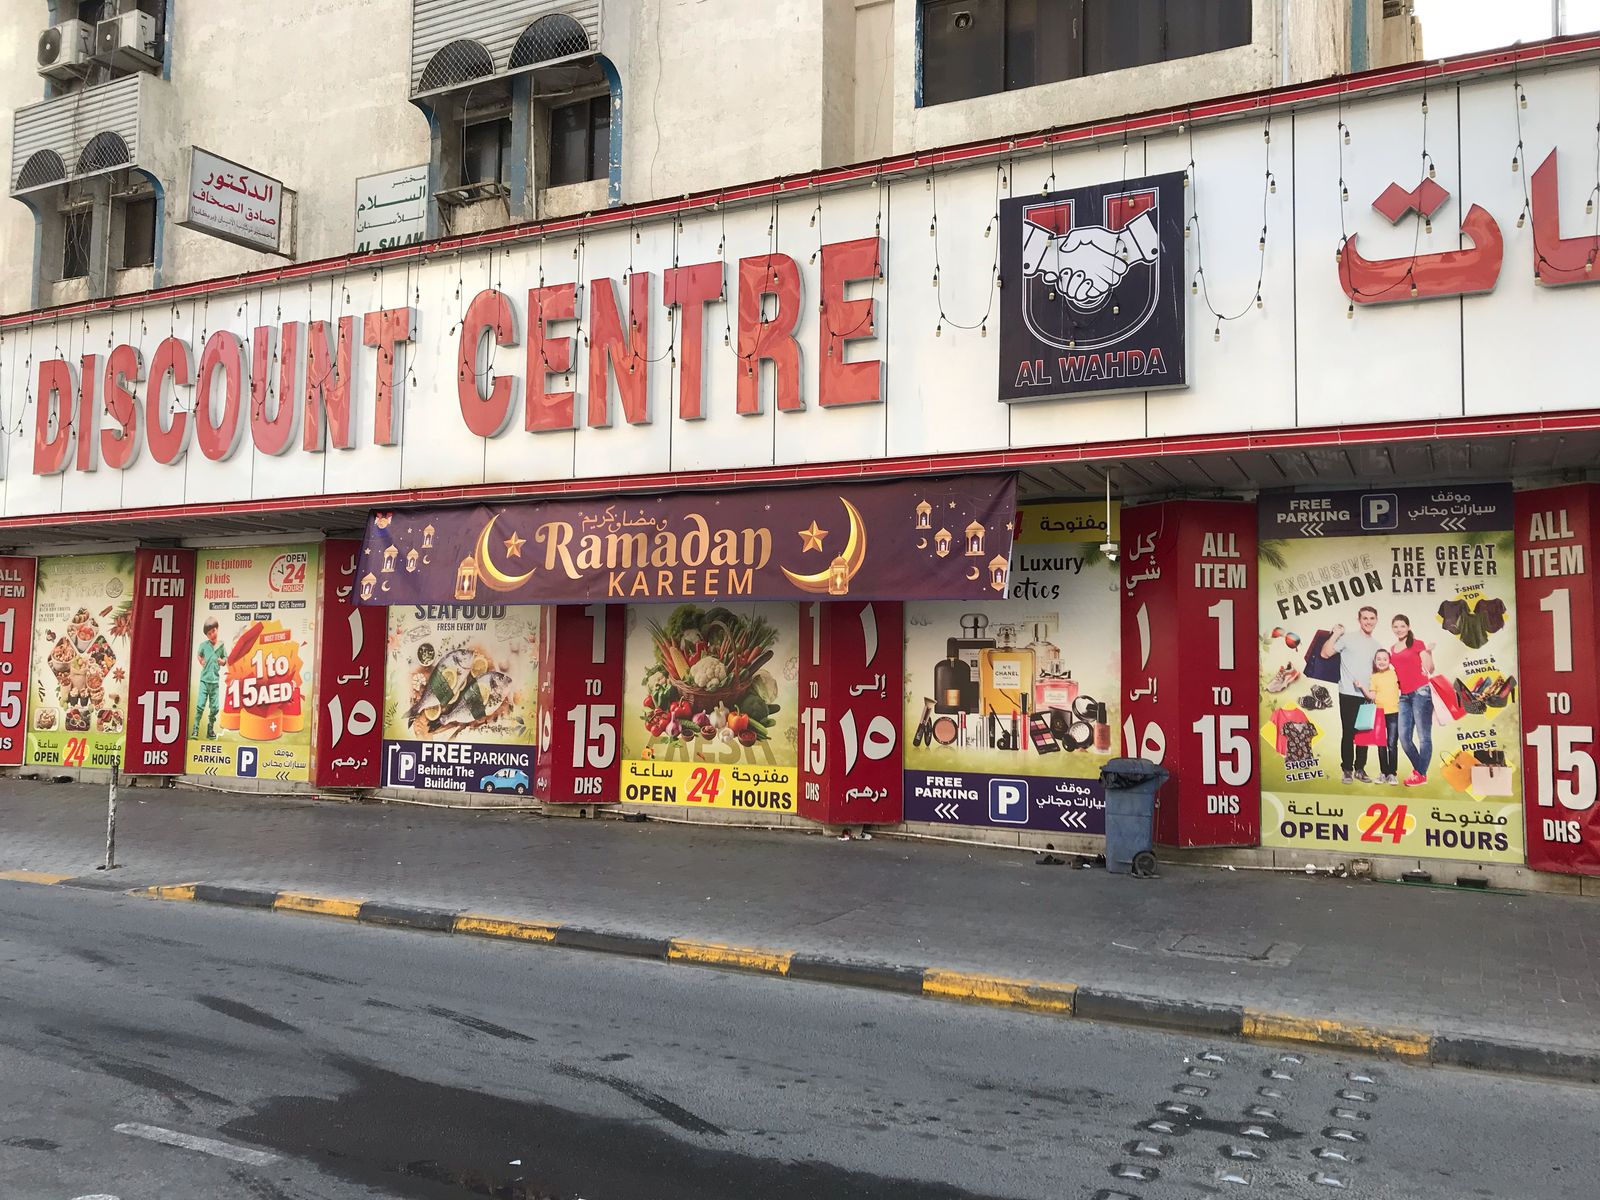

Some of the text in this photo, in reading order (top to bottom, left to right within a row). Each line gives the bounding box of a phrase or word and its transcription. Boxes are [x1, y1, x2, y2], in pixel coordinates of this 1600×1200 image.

[202, 172, 272, 202] الدكتور
[392, 174, 426, 188] مختبر
[357, 185, 426, 219] السلام
[245, 208, 276, 225] صادق
[32, 237, 885, 476] DISCOUNT CENTRE
[1014, 347, 1167, 388] AL WAHDA
[1290, 498, 1332, 510] FREE
[1431, 491, 1471, 503] موقف
[582, 504, 616, 533] كريم
[1277, 510, 1350, 524] PARKING
[1369, 500, 1390, 523] P
[1408, 504, 1496, 521] سيارات مجاني
[1040, 514, 1107, 533] مفتوحة
[1529, 510, 1575, 542] ALL
[534, 513, 772, 580] Ramadan
[1129, 530, 1158, 561] كل
[1202, 532, 1240, 558] ALL
[1391, 544, 1496, 562] THE GREAT
[152, 554, 180, 574] ALL
[206, 559, 252, 570] The Epitome
[286, 554, 307, 562] OPEN
[1020, 555, 1084, 575] Luxury
[1522, 544, 1586, 578] ITEM
[282, 563, 306, 584] 24
[1126, 554, 1161, 597] شي
[1194, 563, 1247, 589] ITEM
[1274, 553, 1374, 598] EXCLUSIVE
[1391, 560, 1498, 578] ARE VEVER
[146, 578, 185, 597] ITEM
[204, 574, 231, 585] of kids
[282, 584, 304, 592] HOURS
[608, 568, 754, 597] KAREEM
[1008, 577, 1060, 600] etics
[1392, 577, 1436, 593] LATE
[1455, 583, 1486, 594] T-SHIRT
[0, 585, 25, 598] TEM
[1276, 570, 1384, 620] FASHION
[1463, 592, 1480, 600] TOP
[414, 604, 507, 621] SEAFOOD
[154, 604, 174, 658] 1
[437, 622, 487, 631] FRESH EVERY DAY
[584, 604, 607, 664] 1
[809, 602, 820, 666] 1
[1208, 599, 1234, 670] 1
[1540, 588, 1573, 672] 1
[1462, 658, 1488, 668] SHOES
[1465, 665, 1497, 676] SANDAL
[154, 670, 168, 684] TO
[337, 666, 370, 686] إلى
[849, 673, 886, 698] إلى
[585, 679, 602, 696] TO
[810, 681, 818, 699] TO
[1129, 677, 1158, 704] إلى
[1212, 687, 1232, 706] TO
[0, 681, 22, 728] 5
[1547, 692, 1570, 714] TO
[138, 690, 180, 744] 15
[328, 694, 377, 749] ١٥
[567, 704, 616, 768] 15
[801, 707, 826, 776] 15
[839, 708, 896, 776] ١٥
[1456, 728, 1497, 740] BAGS &
[34, 737, 120, 767] OPEN 24 HOURS
[200, 744, 222, 754] FREE
[422, 743, 529, 767] FREE PARKING
[1193, 715, 1252, 787] 15
[1461, 740, 1498, 752] PURSE
[144, 750, 168, 765] DHS
[193, 754, 231, 764] PARKING
[241, 750, 254, 772] P
[331, 754, 368, 770] درهم
[400, 754, 414, 779] P
[1285, 758, 1320, 771] SHORT
[1526, 725, 1598, 810] 15
[418, 764, 475, 778] Behind The
[630, 762, 789, 786] مفتوحة ساعة
[1286, 770, 1324, 782] SLEEVE
[424, 778, 466, 792] Building
[574, 777, 602, 794] DHS
[626, 767, 792, 809] OPEN 24 HOURS
[805, 780, 820, 801] DHS
[926, 776, 962, 787] FREE
[1055, 782, 1091, 795] موقف
[846, 784, 888, 803] درهم
[915, 787, 978, 800] PARKING
[998, 786, 1020, 815] P
[1036, 794, 1106, 809] يارات مجاني
[1207, 795, 1240, 814] DHS
[1287, 800, 1508, 828] مفتوحة ساعة
[1280, 802, 1509, 852] OPEN 24 HOURS
[1542, 819, 1582, 844] DHS
